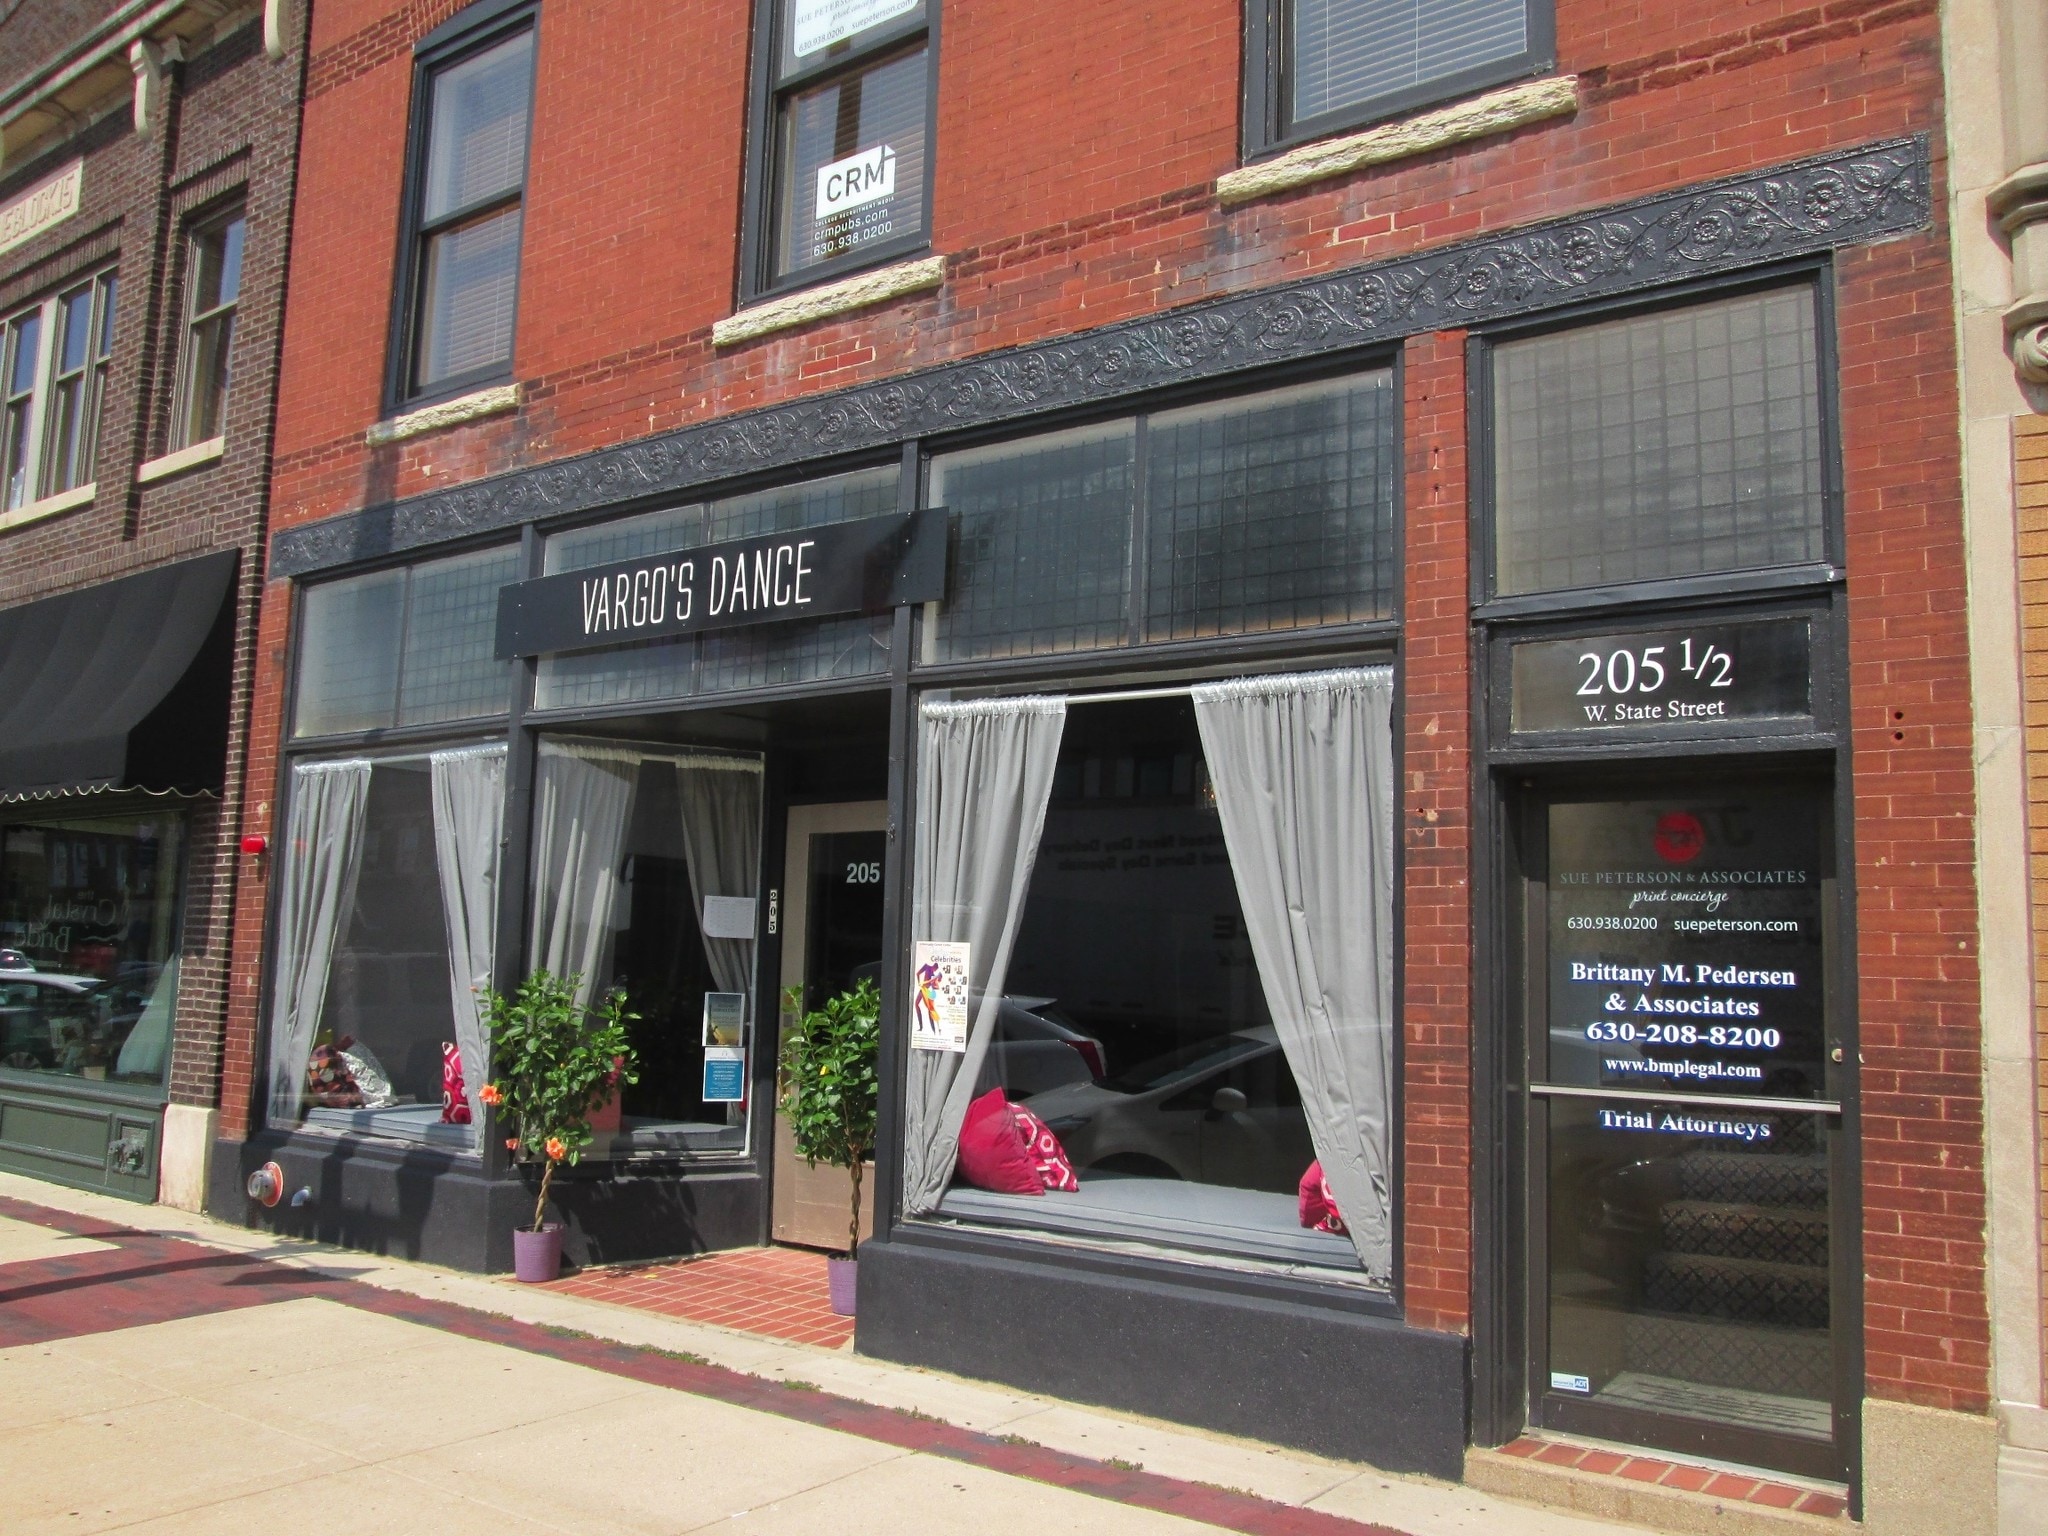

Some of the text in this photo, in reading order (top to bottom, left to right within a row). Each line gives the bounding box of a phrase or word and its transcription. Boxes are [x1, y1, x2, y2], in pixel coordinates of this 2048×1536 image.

[798, 26, 845, 53] 630.938.0200
[825, 148, 886, 203] CRM
[814, 196, 895, 228] COLLEGE RECRUITMENT MEDIA
[814, 208, 888, 241] crmpubs.com
[813, 221, 892, 257] 630.938.0200
[583, 541, 815, 635] VARGO'S DANCE
[1576, 646, 1665, 696] 205
[1584, 700, 1725, 722] W. State Street
[846, 862, 881, 884] 205
[1560, 870, 1807, 884] SUE PETERSON & ASSOCIATES
[768, 890, 778, 933] 205
[1629, 890, 1729, 912] print concierge
[1567, 917, 1798, 933] 630.938.0200 suepeterson.com
[930, 955, 962, 965] Celebrities
[1571, 962, 1796, 987] Brittany M. Pedersen
[1604, 993, 1760, 1016] & Associates
[1586, 1021, 1780, 1048] 630-208-8200
[1605, 1058, 1761, 1080] www.bmplegal.com
[1600, 1109, 1771, 1140] Trial Attorneys
